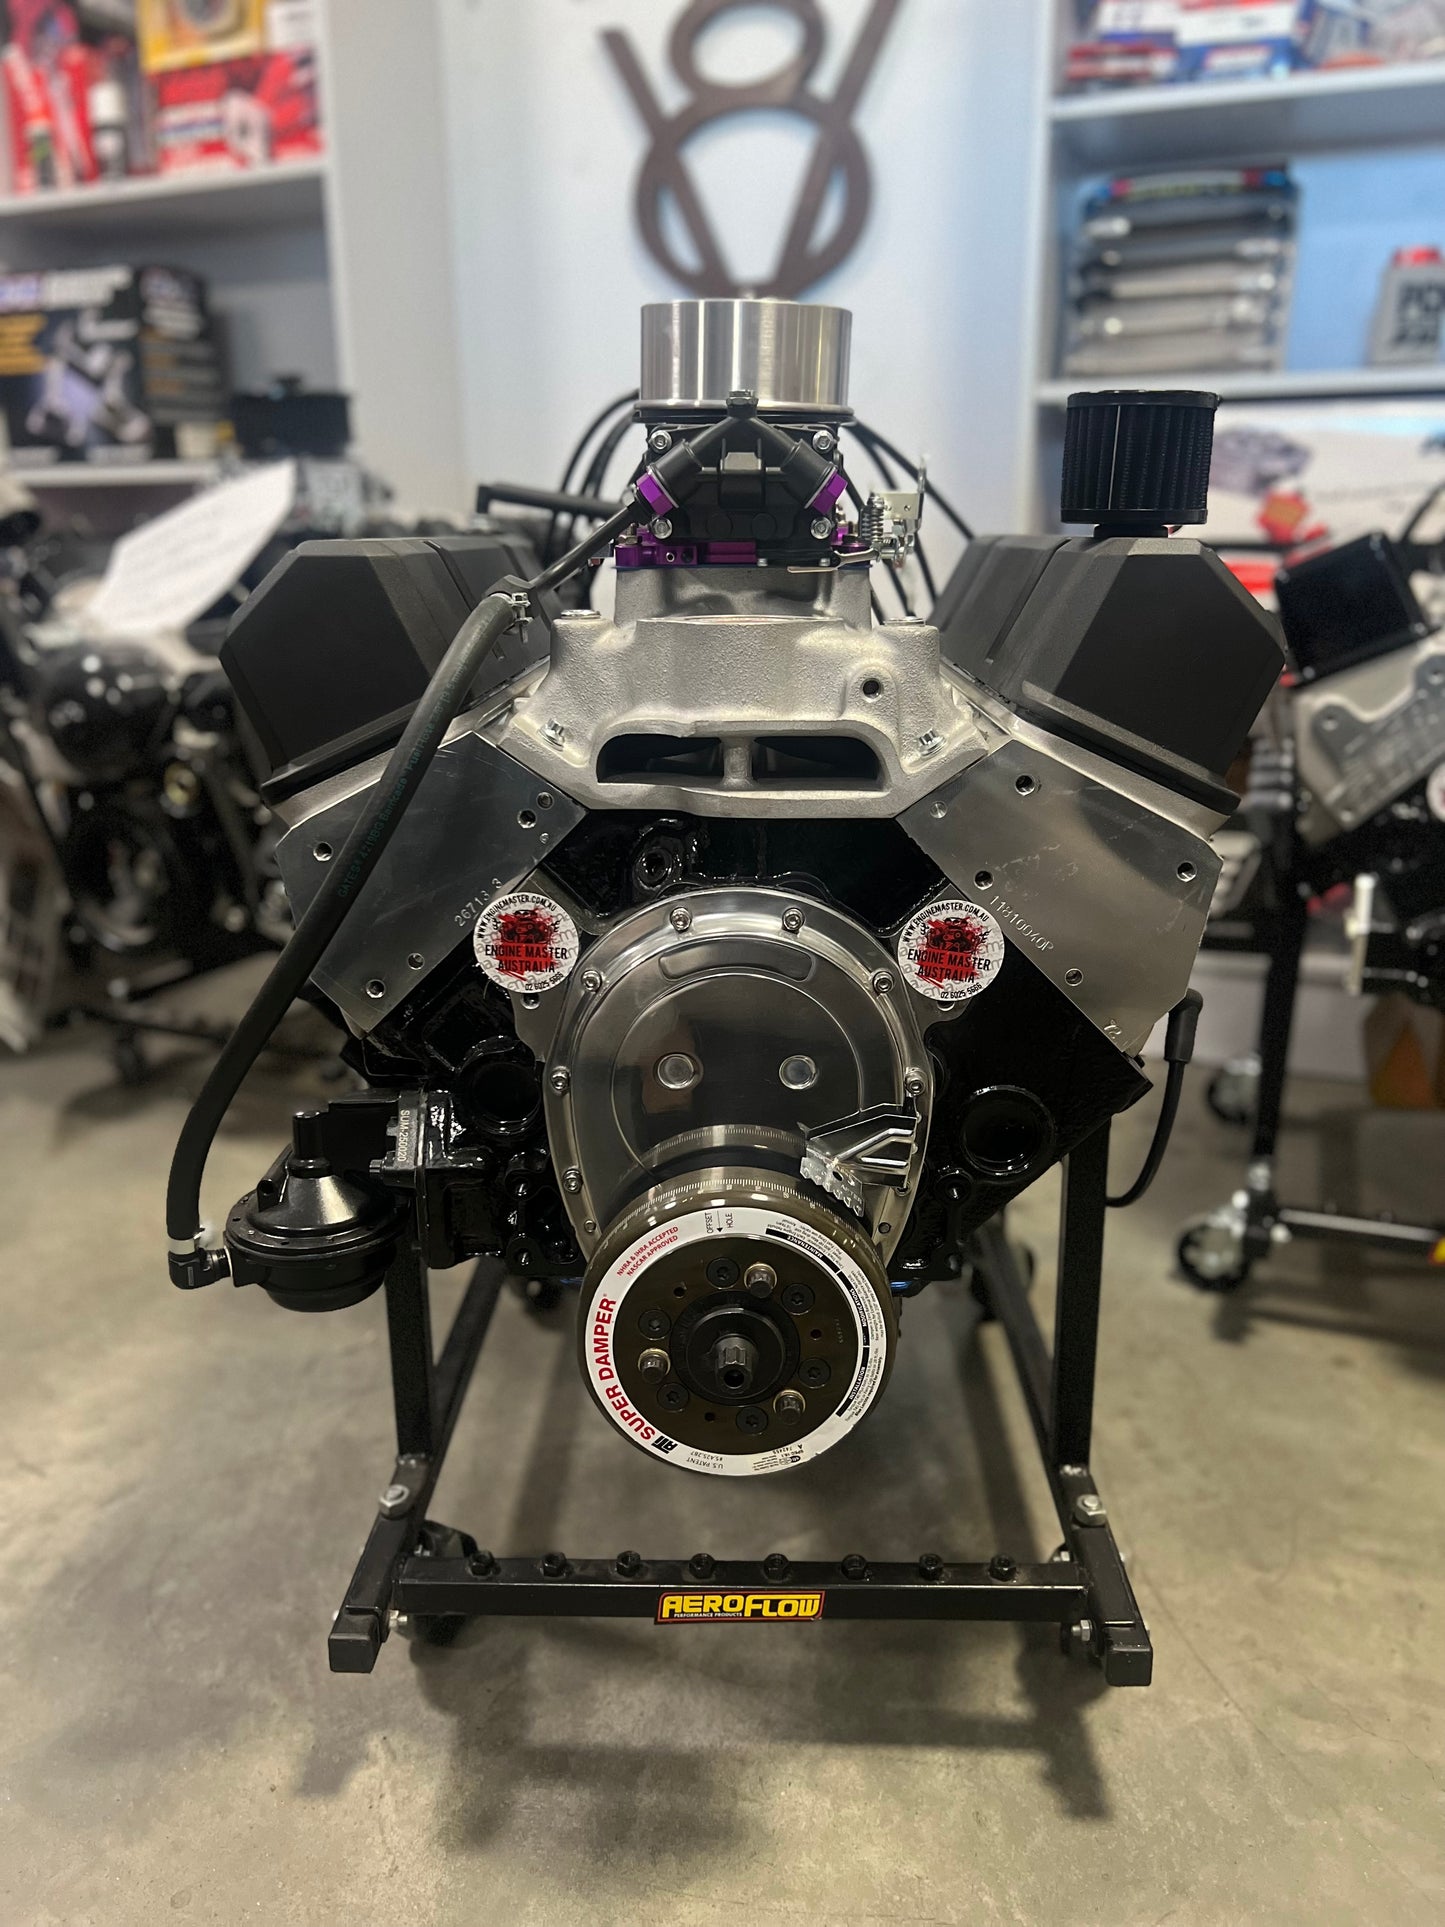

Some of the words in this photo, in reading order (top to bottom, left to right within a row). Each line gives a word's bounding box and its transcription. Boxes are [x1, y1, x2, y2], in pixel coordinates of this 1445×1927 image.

[338, 864, 361, 897] GATES
[903, 902, 989, 942] WWW.ENGINEMASTER.COM.AU
[485, 945, 521, 957] ENGINE
[525, 946, 568, 959] MASTER
[498, 960, 555, 972] AUSTRALIA
[907, 949, 945, 964] ENGINE
[948, 953, 990, 970] MASTER
[918, 965, 975, 982] AUSTRALIA
[951, 989, 966, 998] 6025
[397, 1109, 409, 1161] SUM-250020
[616, 1259, 632, 1276] NHRA
[633, 1243, 648, 1256] IHRA
[646, 1225, 679, 1246] ACCEPTED
[625, 1254, 648, 1276] NASCAR
[645, 1234, 678, 1256] APPROVED
[786, 1235, 823, 1258] MAINTENANCE
[848, 1288, 866, 1326] MODIFICATIONS
[848, 1366, 865, 1399] INSTALLATION
[603, 1383, 657, 1442] SUPER
[686, 1457, 709, 1467] PATENT
[662, 1594, 820, 1618] AEROFLOW
